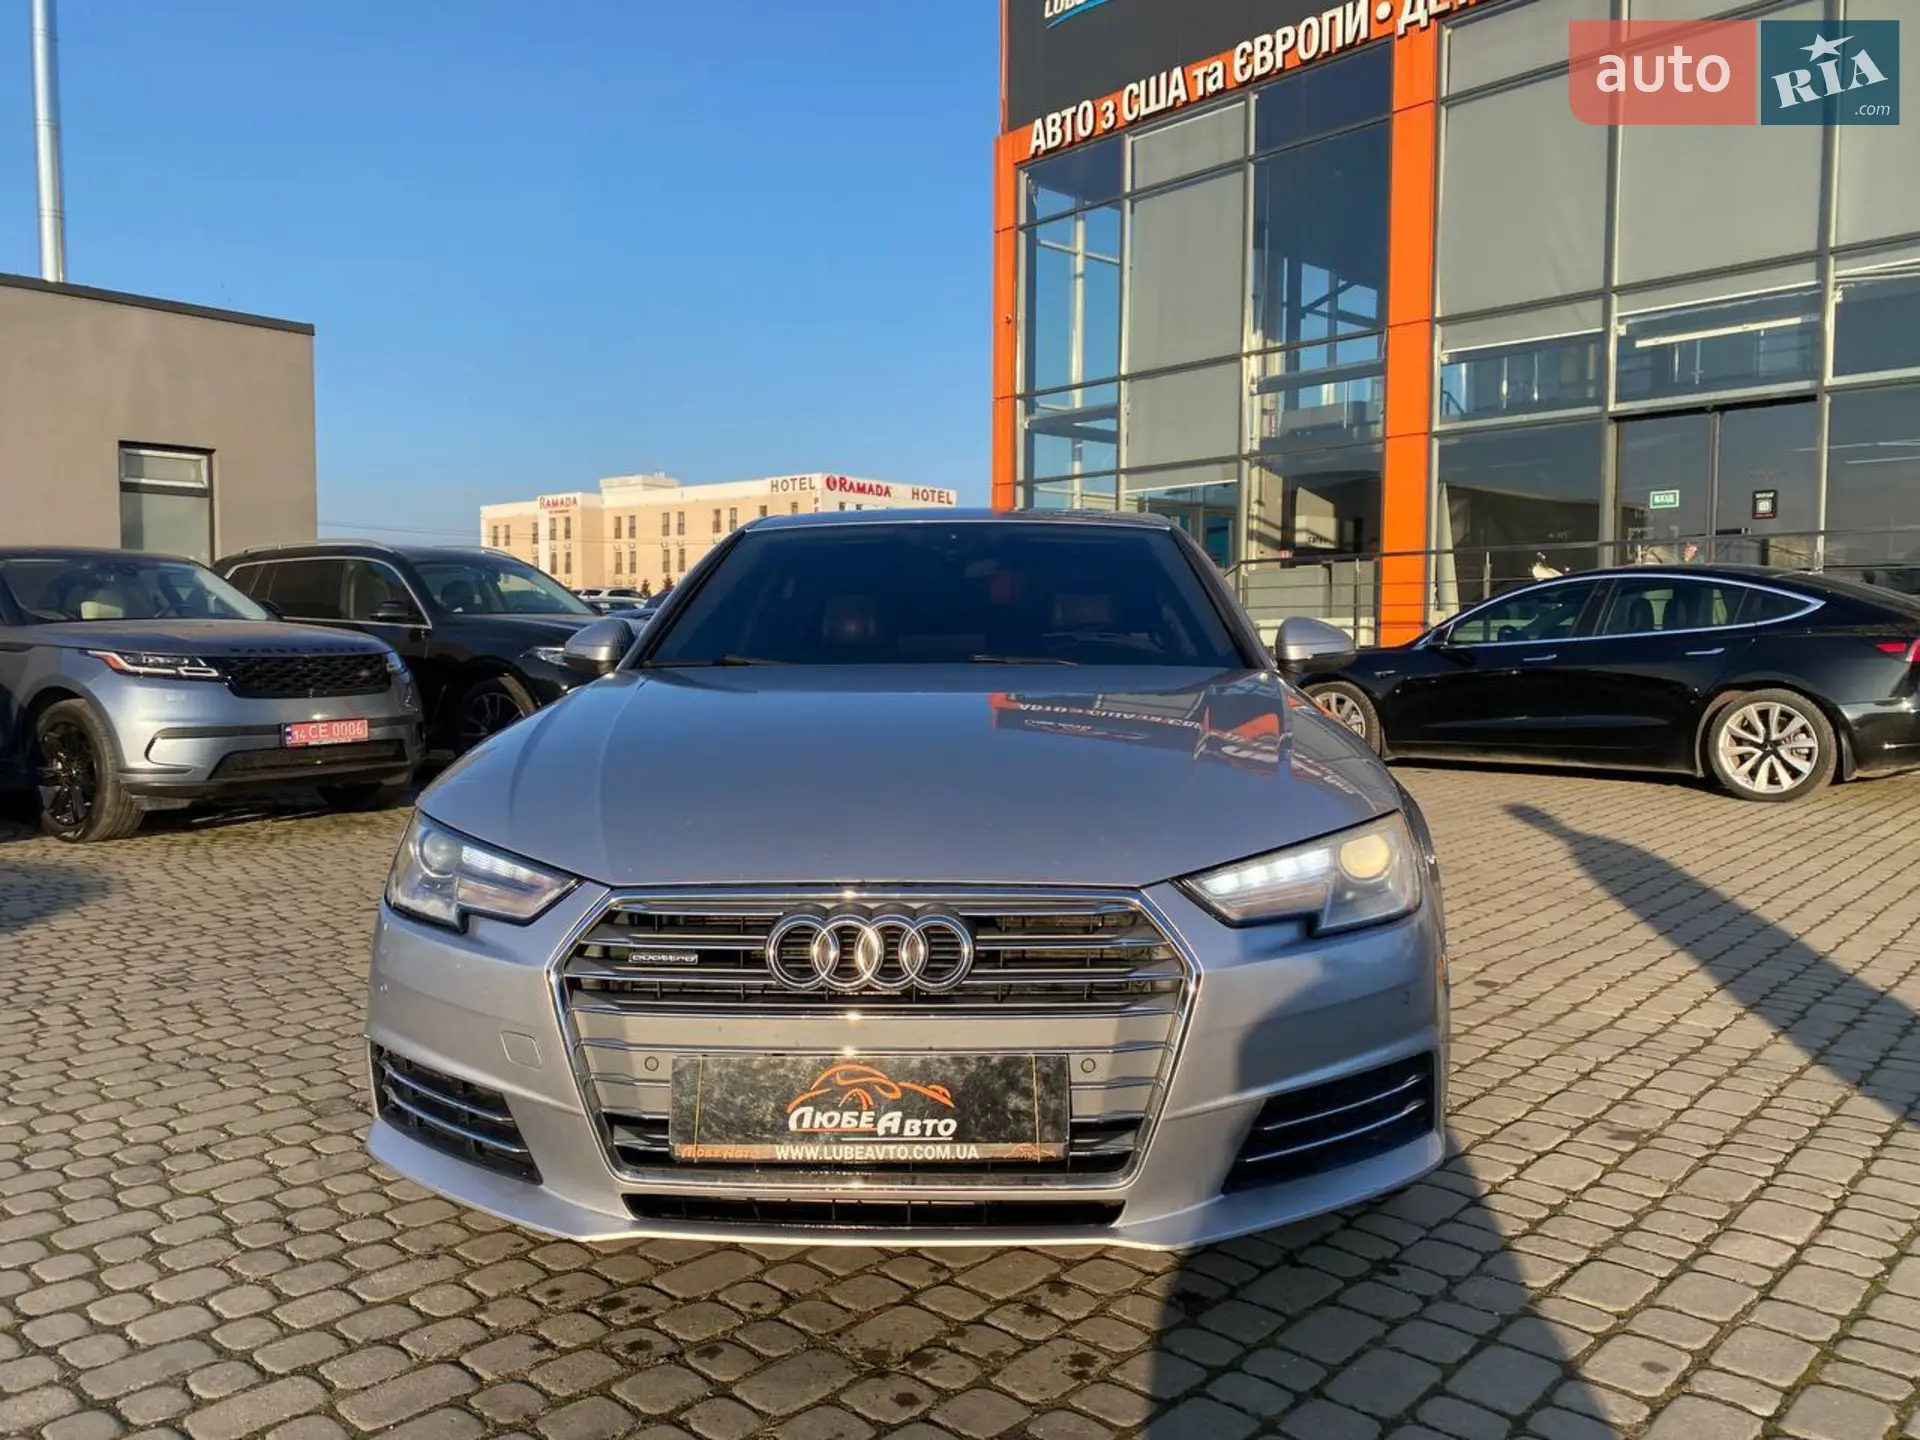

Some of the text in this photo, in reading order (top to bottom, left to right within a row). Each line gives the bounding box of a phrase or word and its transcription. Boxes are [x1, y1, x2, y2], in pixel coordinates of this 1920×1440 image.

[1029, 99, 1094, 155] АВТО
[1122, 66, 1189, 124] США
[1191, 57, 1225, 92] та
[1233, 2, 1370, 83] ЄВРОПИ
[770, 476, 954, 505] HOTEL RAMADA HOTEL
[539, 495, 577, 510] RAMADA
[309, 724, 329, 739] CE
[775, 1144, 980, 1161] WWW.LUBEAVTO.COM.UA
